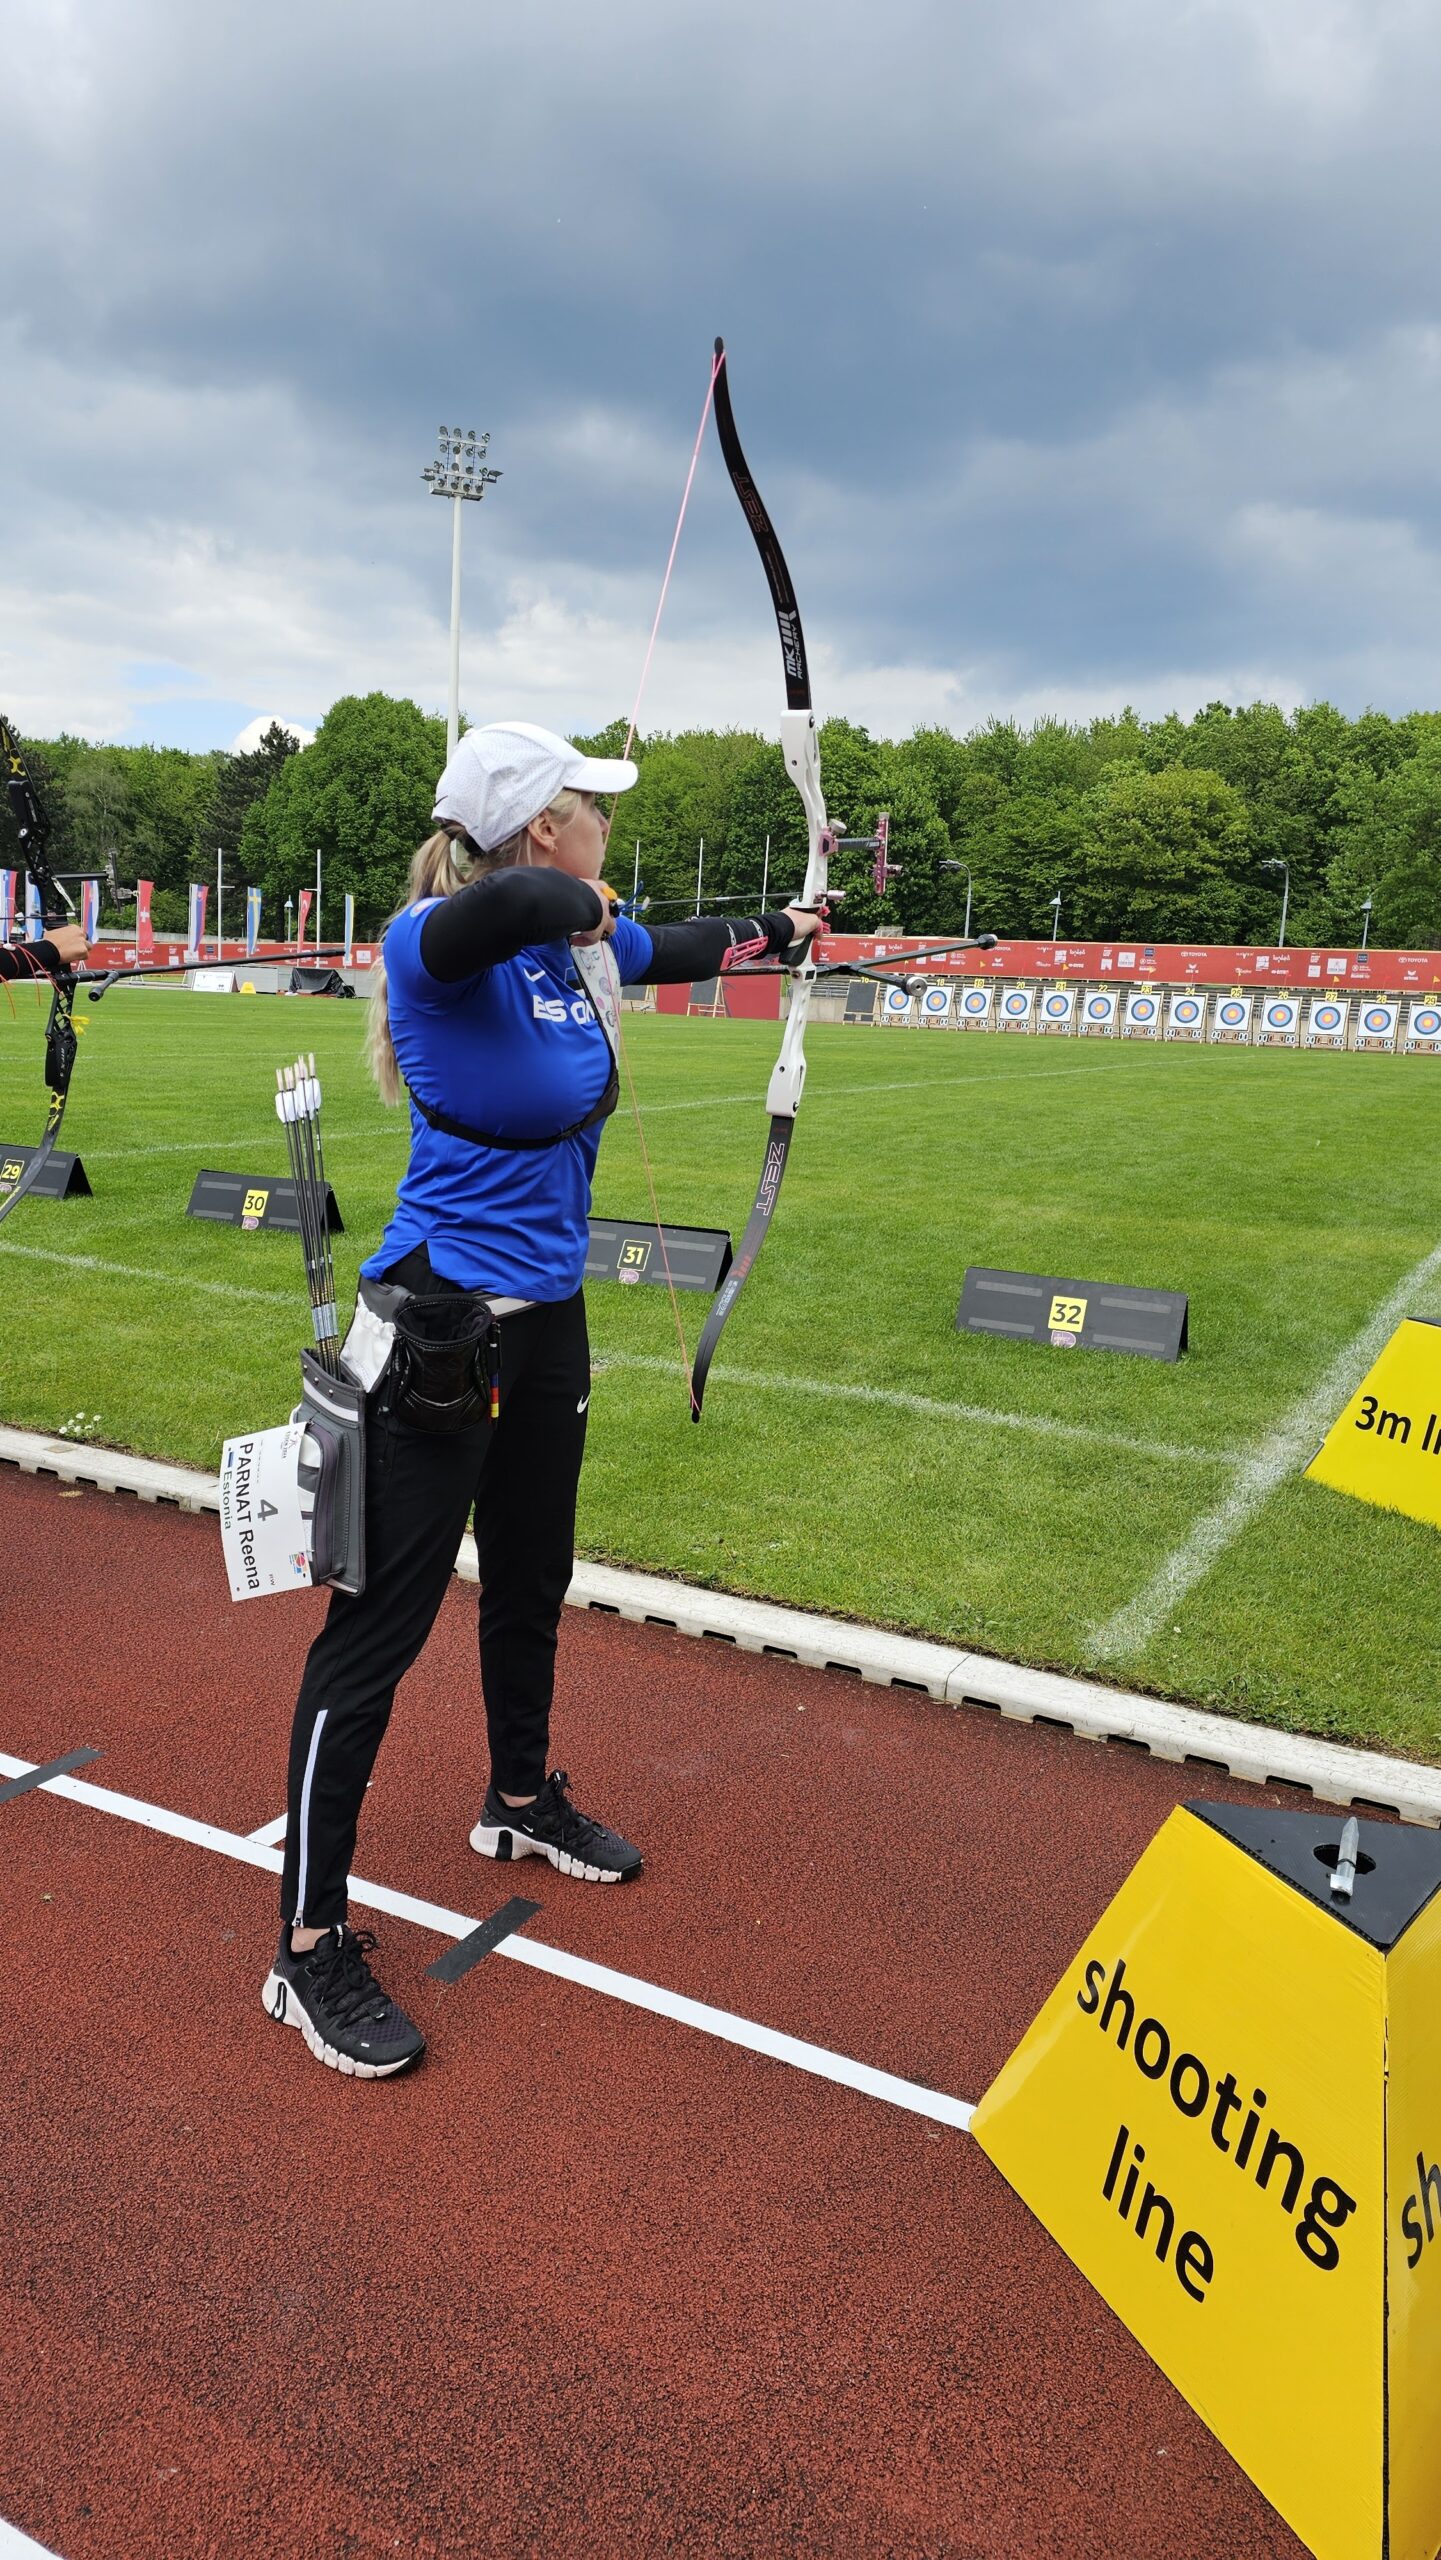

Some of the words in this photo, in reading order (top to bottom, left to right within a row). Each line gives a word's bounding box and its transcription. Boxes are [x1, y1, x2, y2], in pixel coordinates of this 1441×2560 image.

[791, 622, 804, 680] ARCHERY
[1, 1164, 20, 1180] 29
[756, 1141, 785, 1216] ZEST
[245, 1195, 265, 1211] 30
[623, 1246, 644, 1265] 31
[1052, 1303, 1082, 1325] 32
[1354, 1395, 1412, 1445] 3m
[222, 1470, 233, 1531] Estonia
[235, 1442, 254, 1523] PARNAT
[257, 1498, 279, 1522] 4
[239, 1529, 260, 1590] Reena
[1076, 1957, 1357, 2271] shooting
[1101, 2124, 1215, 2304] line
